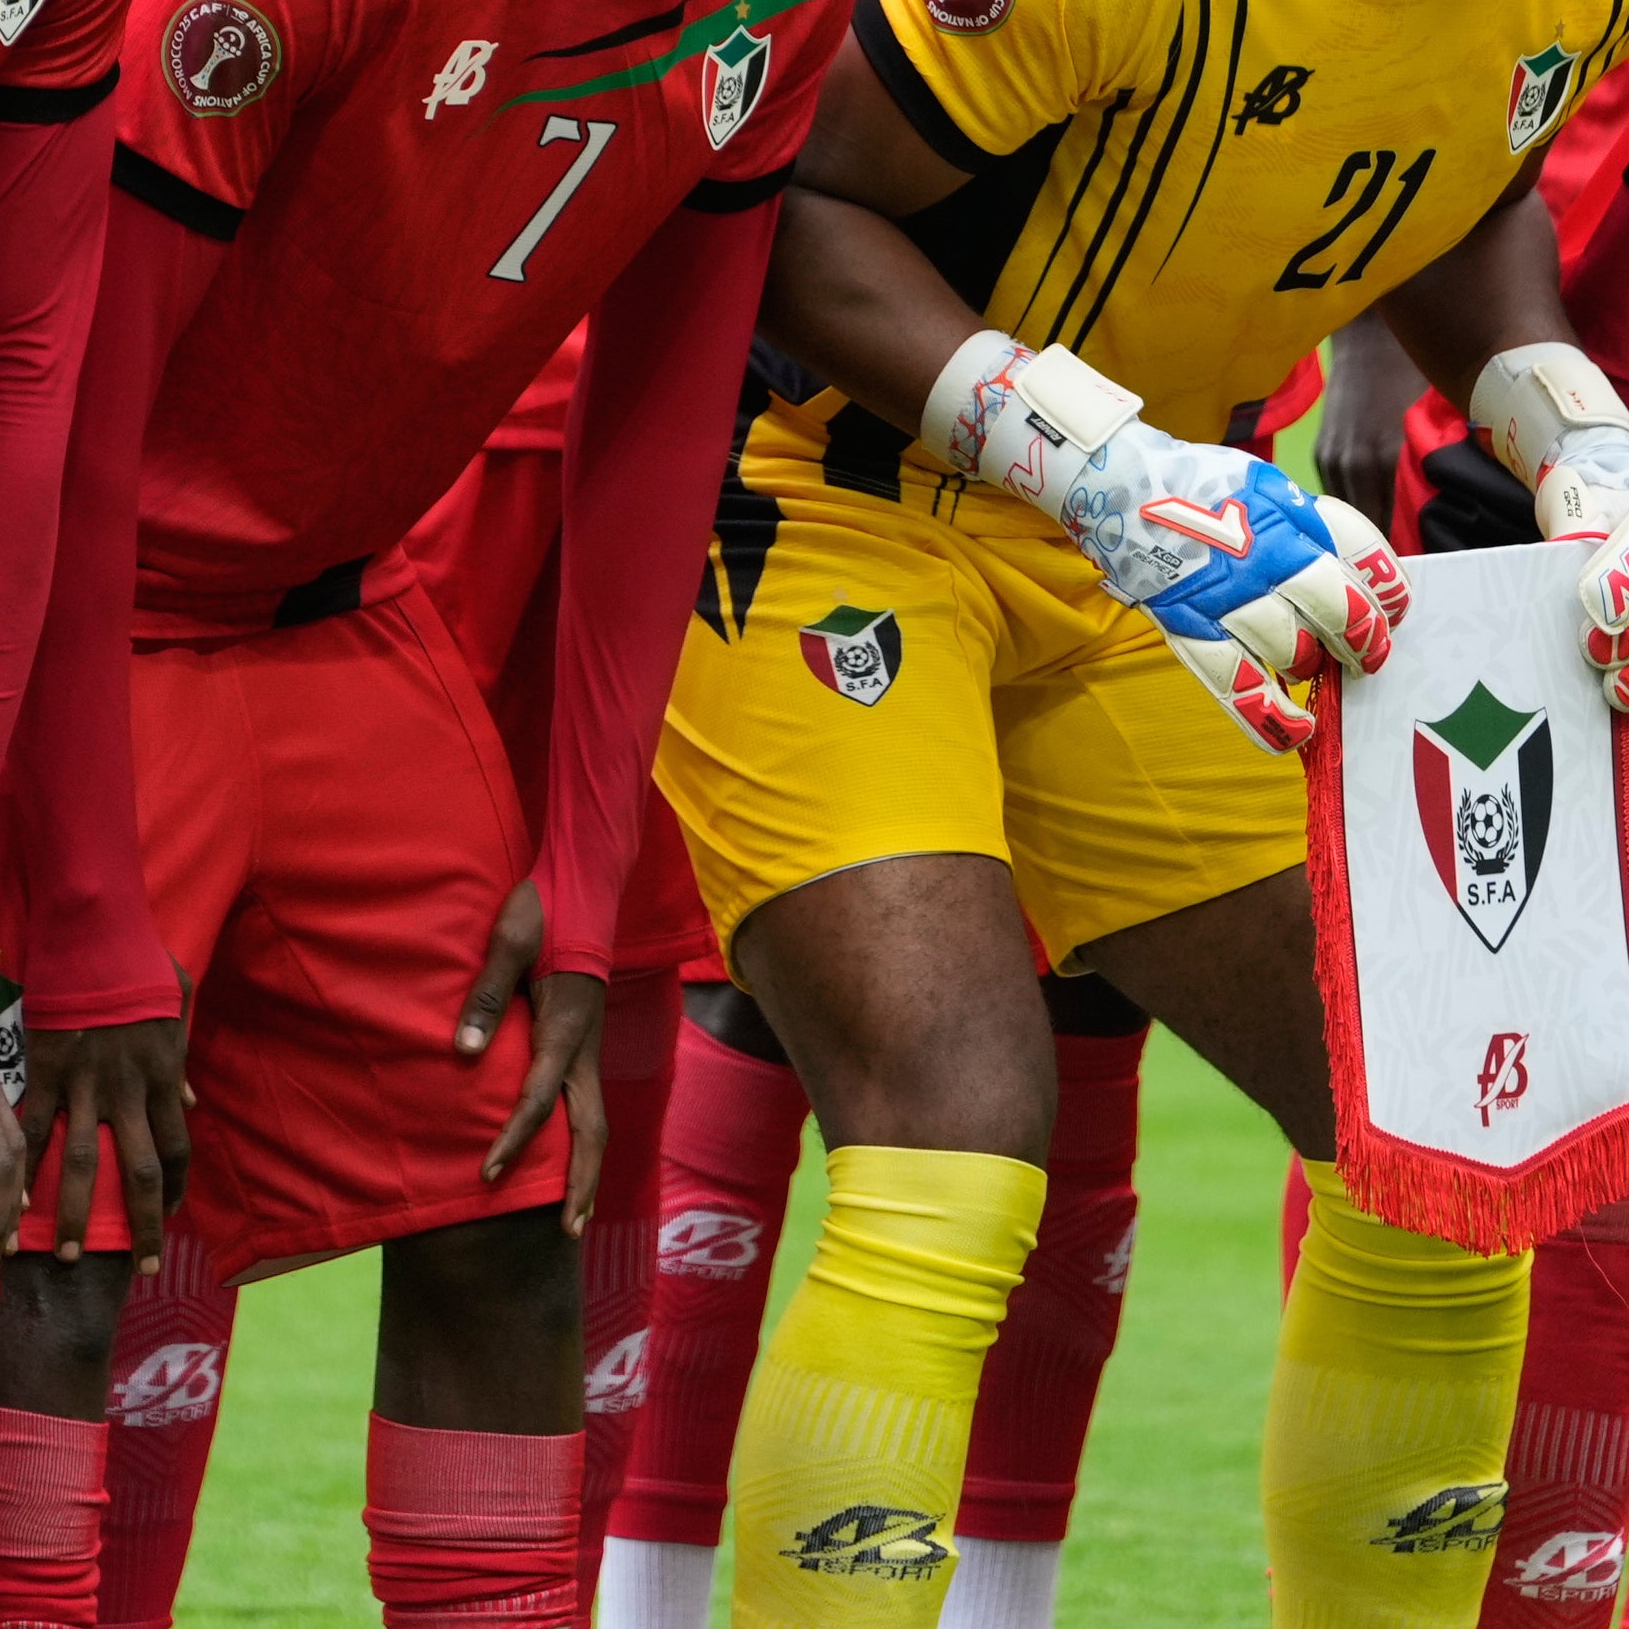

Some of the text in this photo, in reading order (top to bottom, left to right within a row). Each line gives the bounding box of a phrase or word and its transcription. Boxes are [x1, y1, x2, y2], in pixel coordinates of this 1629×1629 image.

[0, 5, 25, 22] S.F.A
[191, 2, 222, 20] CAF
[927, 0, 974, 27] NATIONS
[975, 15, 989, 27] OF
[171, 17, 192, 100] MOROCCO 25
[193, 20, 272, 108] AFRICA CUP OF NATIONS
[422, 40, 499, 120] AB
[1232, 65, 1315, 136] AB
[712, 112, 735, 126] S.F.A
[1512, 118, 1535, 131] S.F.A
[489, 116, 617, 282] 7
[1272, 148, 1437, 293] 21
[846, 678, 883, 692] S.F.A
[1467, 880, 1516, 906] S.F.A
[1474, 1032, 1530, 1127] AB
[1496, 1099, 1519, 1110] SPORT
[823, 1558, 940, 1582] SPORT
